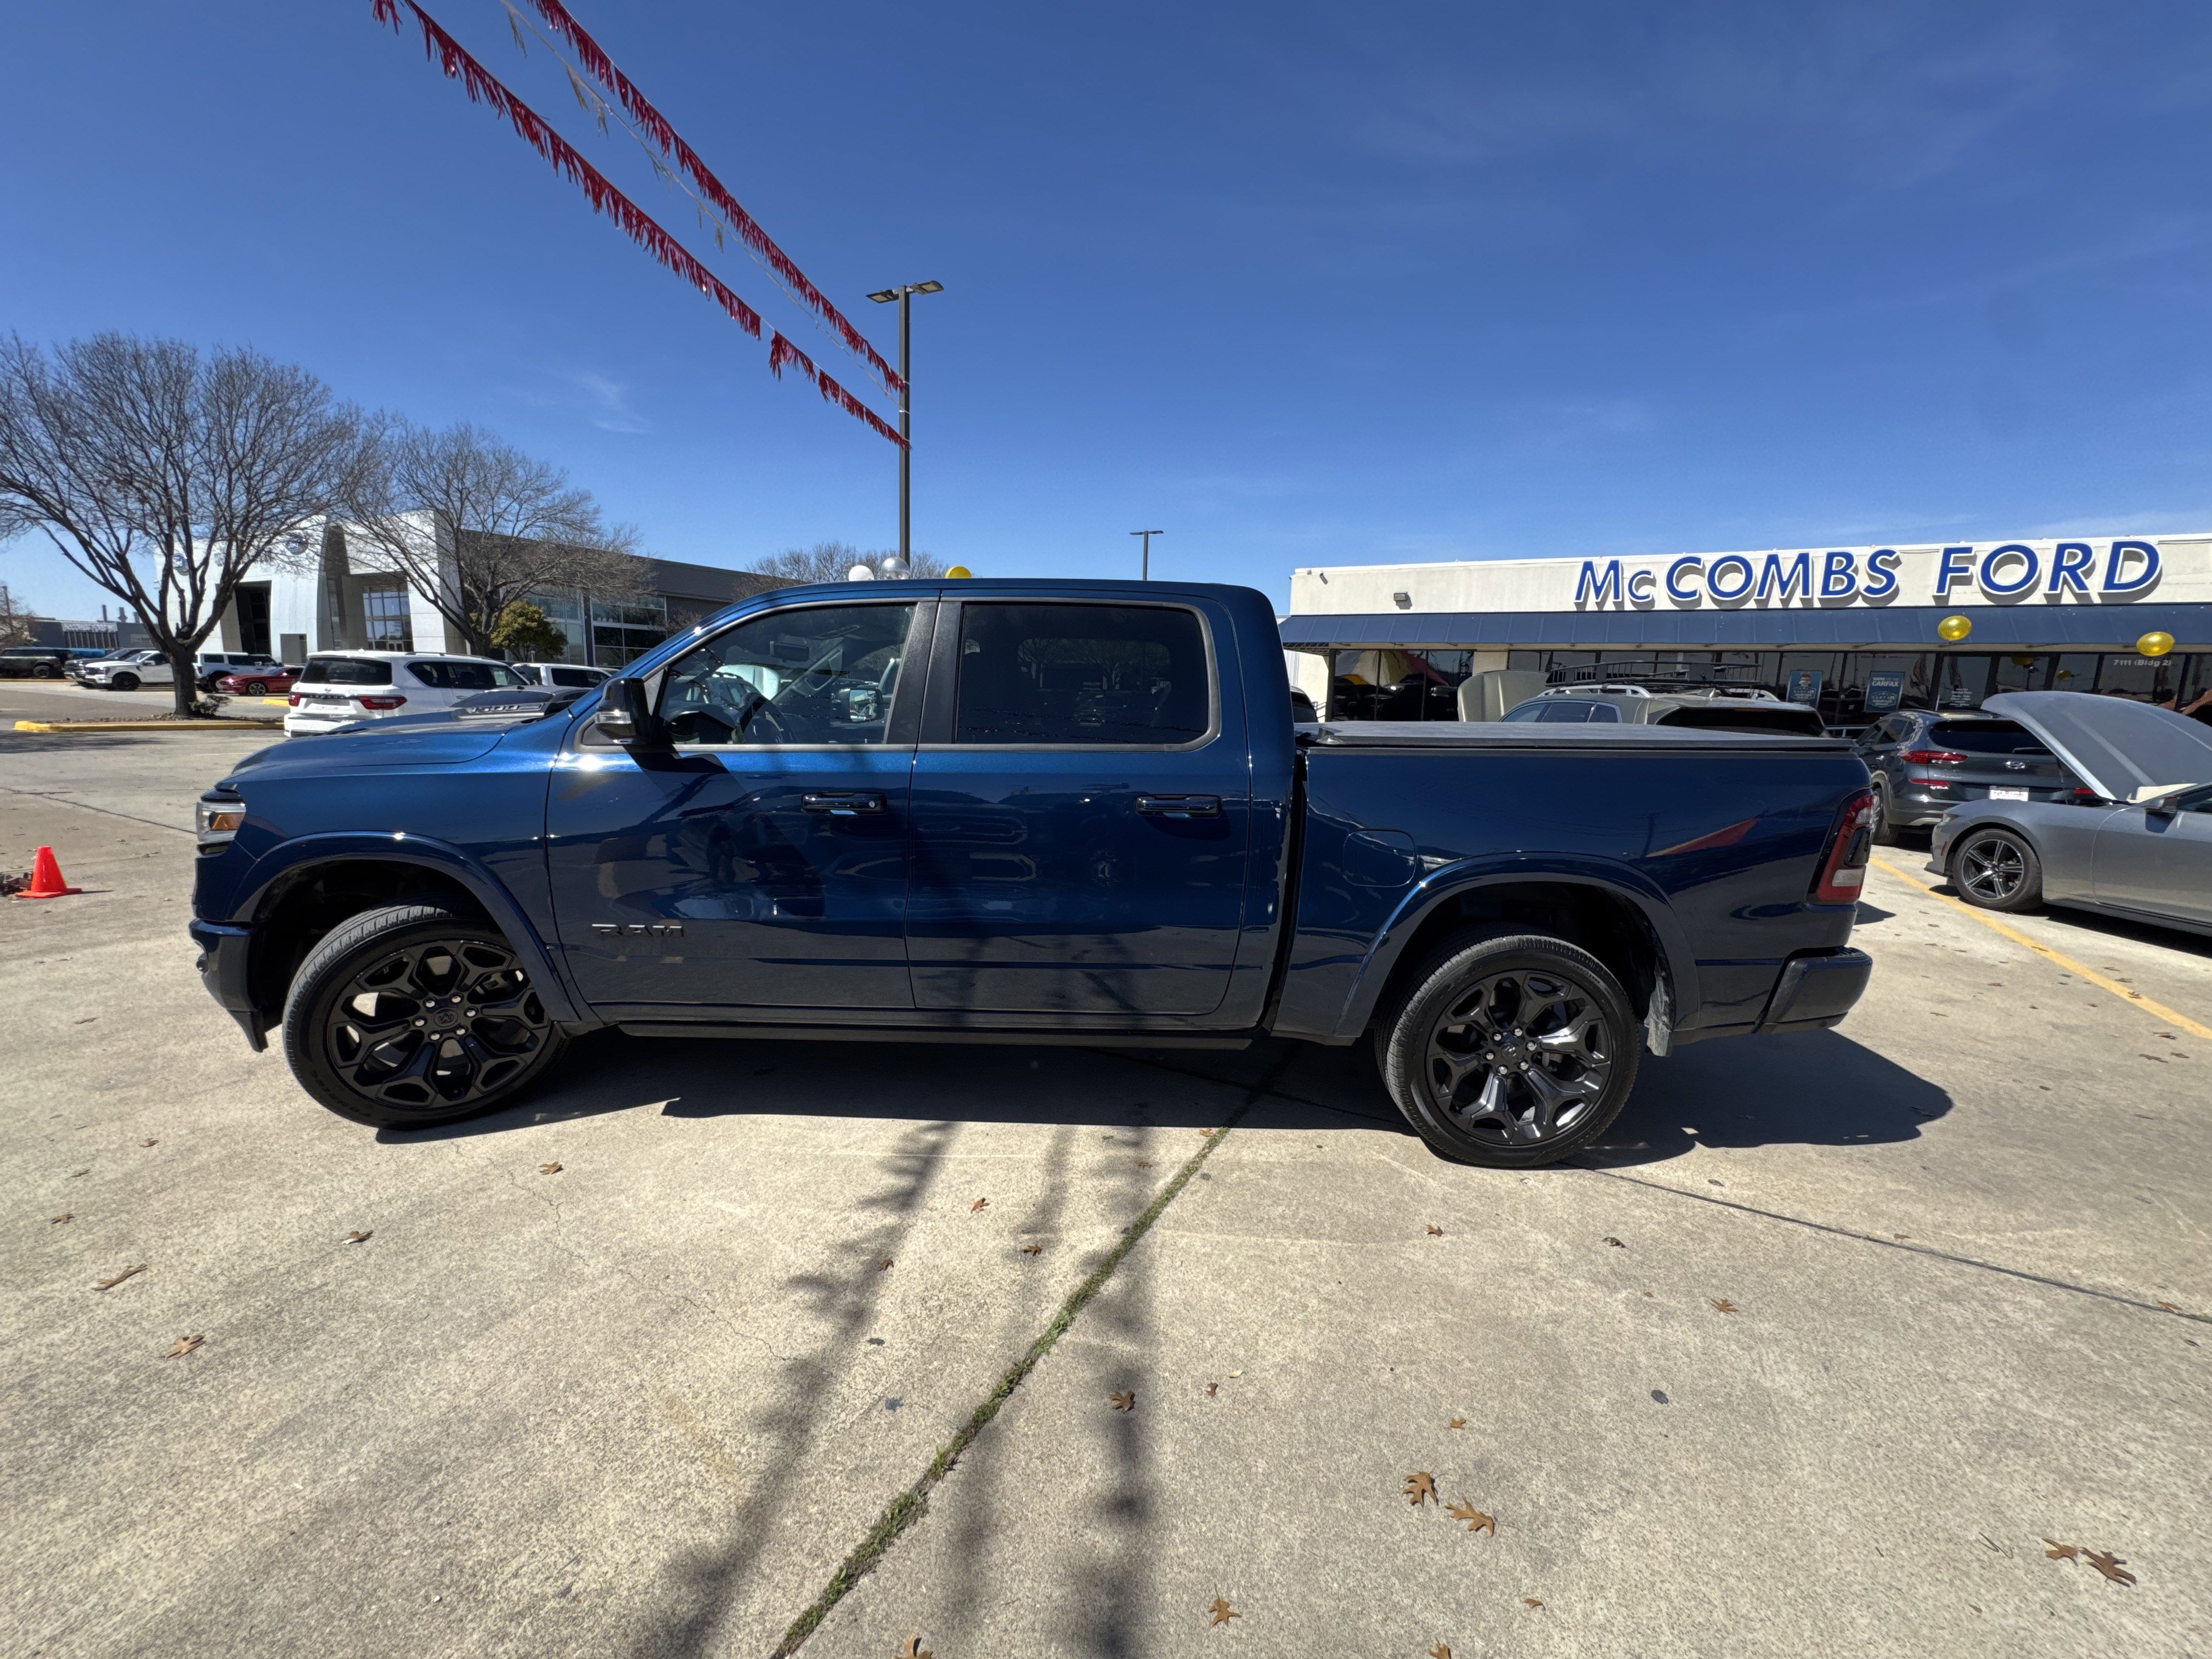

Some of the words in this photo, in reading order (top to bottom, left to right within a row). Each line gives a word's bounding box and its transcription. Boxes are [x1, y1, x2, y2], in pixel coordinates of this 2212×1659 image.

[1932, 539, 2162, 596] FORD
[471, 704, 520, 713] 1500
[592, 924, 684, 937] RAM
